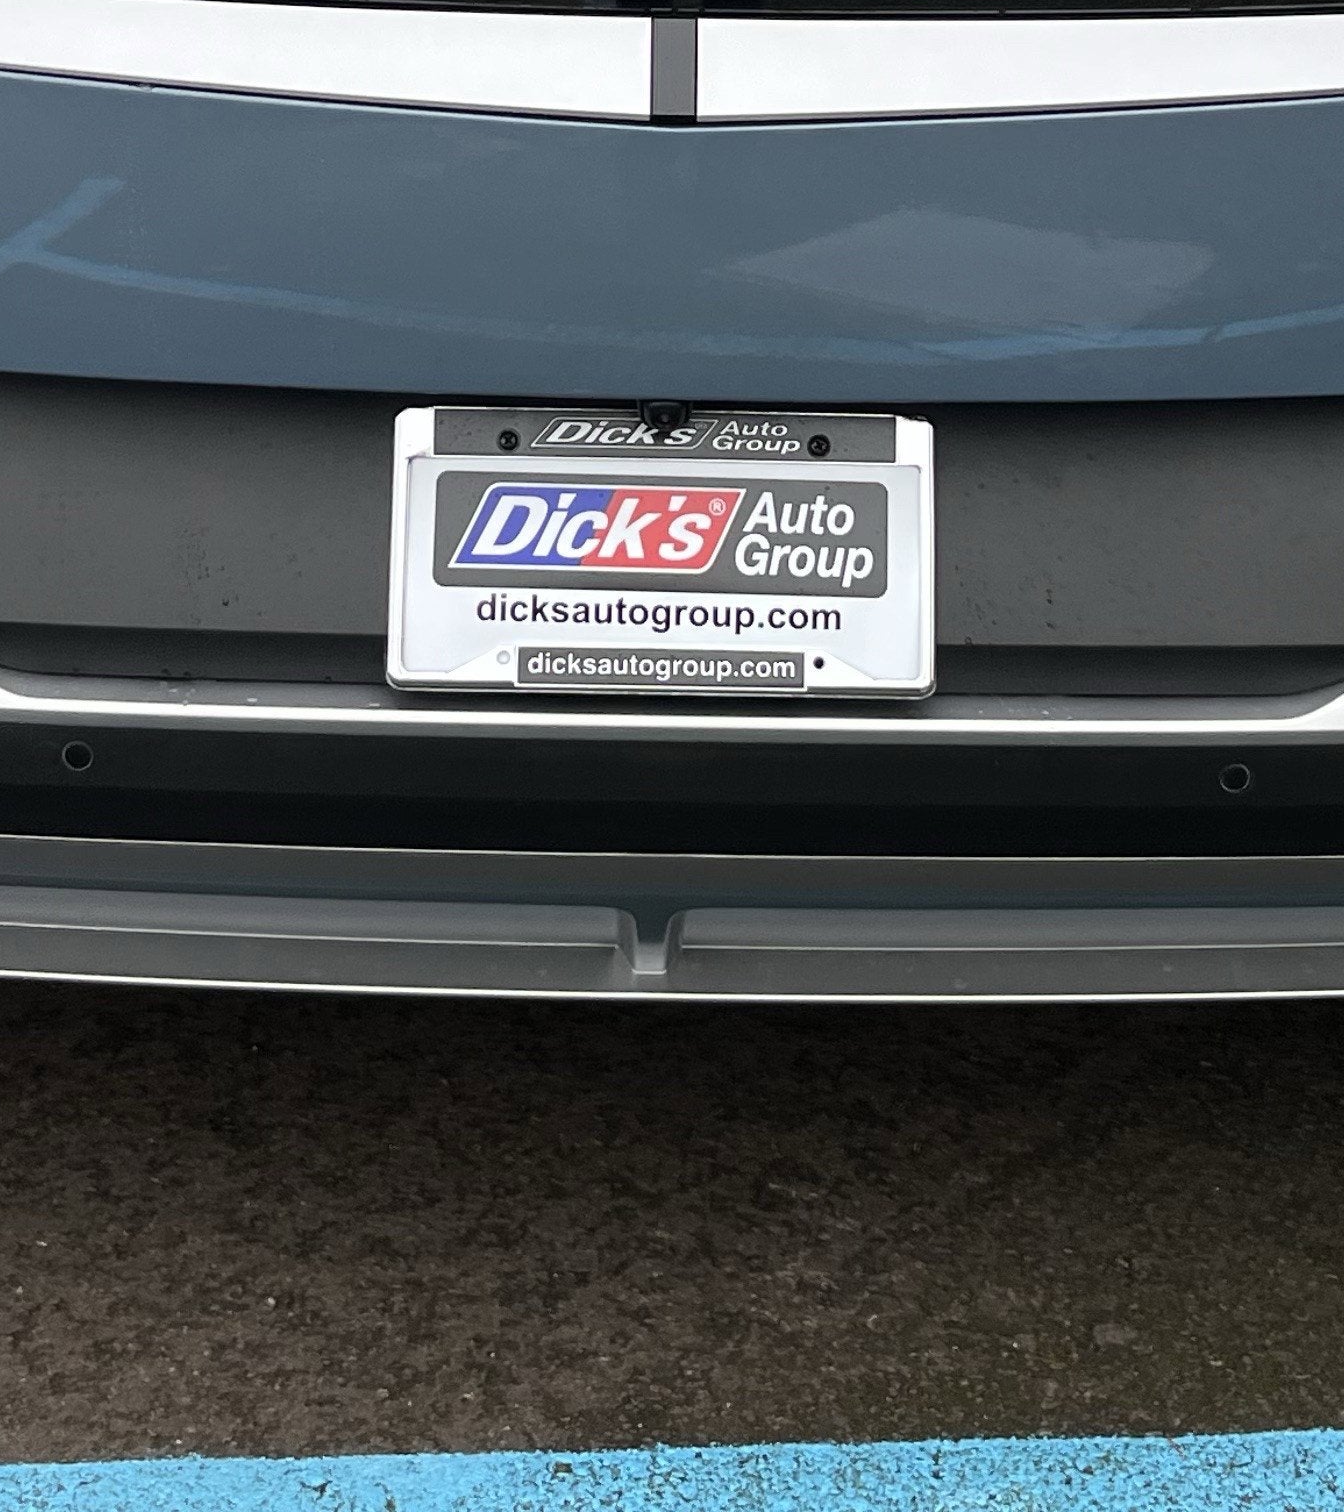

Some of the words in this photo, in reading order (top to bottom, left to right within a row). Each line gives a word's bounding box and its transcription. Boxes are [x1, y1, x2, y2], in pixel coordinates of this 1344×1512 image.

[545, 420, 698, 446] Dicks
[712, 435, 801, 454] Group
[720, 420, 788, 436] Auto
[470, 491, 712, 563] Dick's
[742, 491, 855, 536] Auto
[734, 533, 874, 587] Group
[476, 593, 842, 635] dicksautogroup.com
[527, 651, 796, 680] dicksautogroup.com
